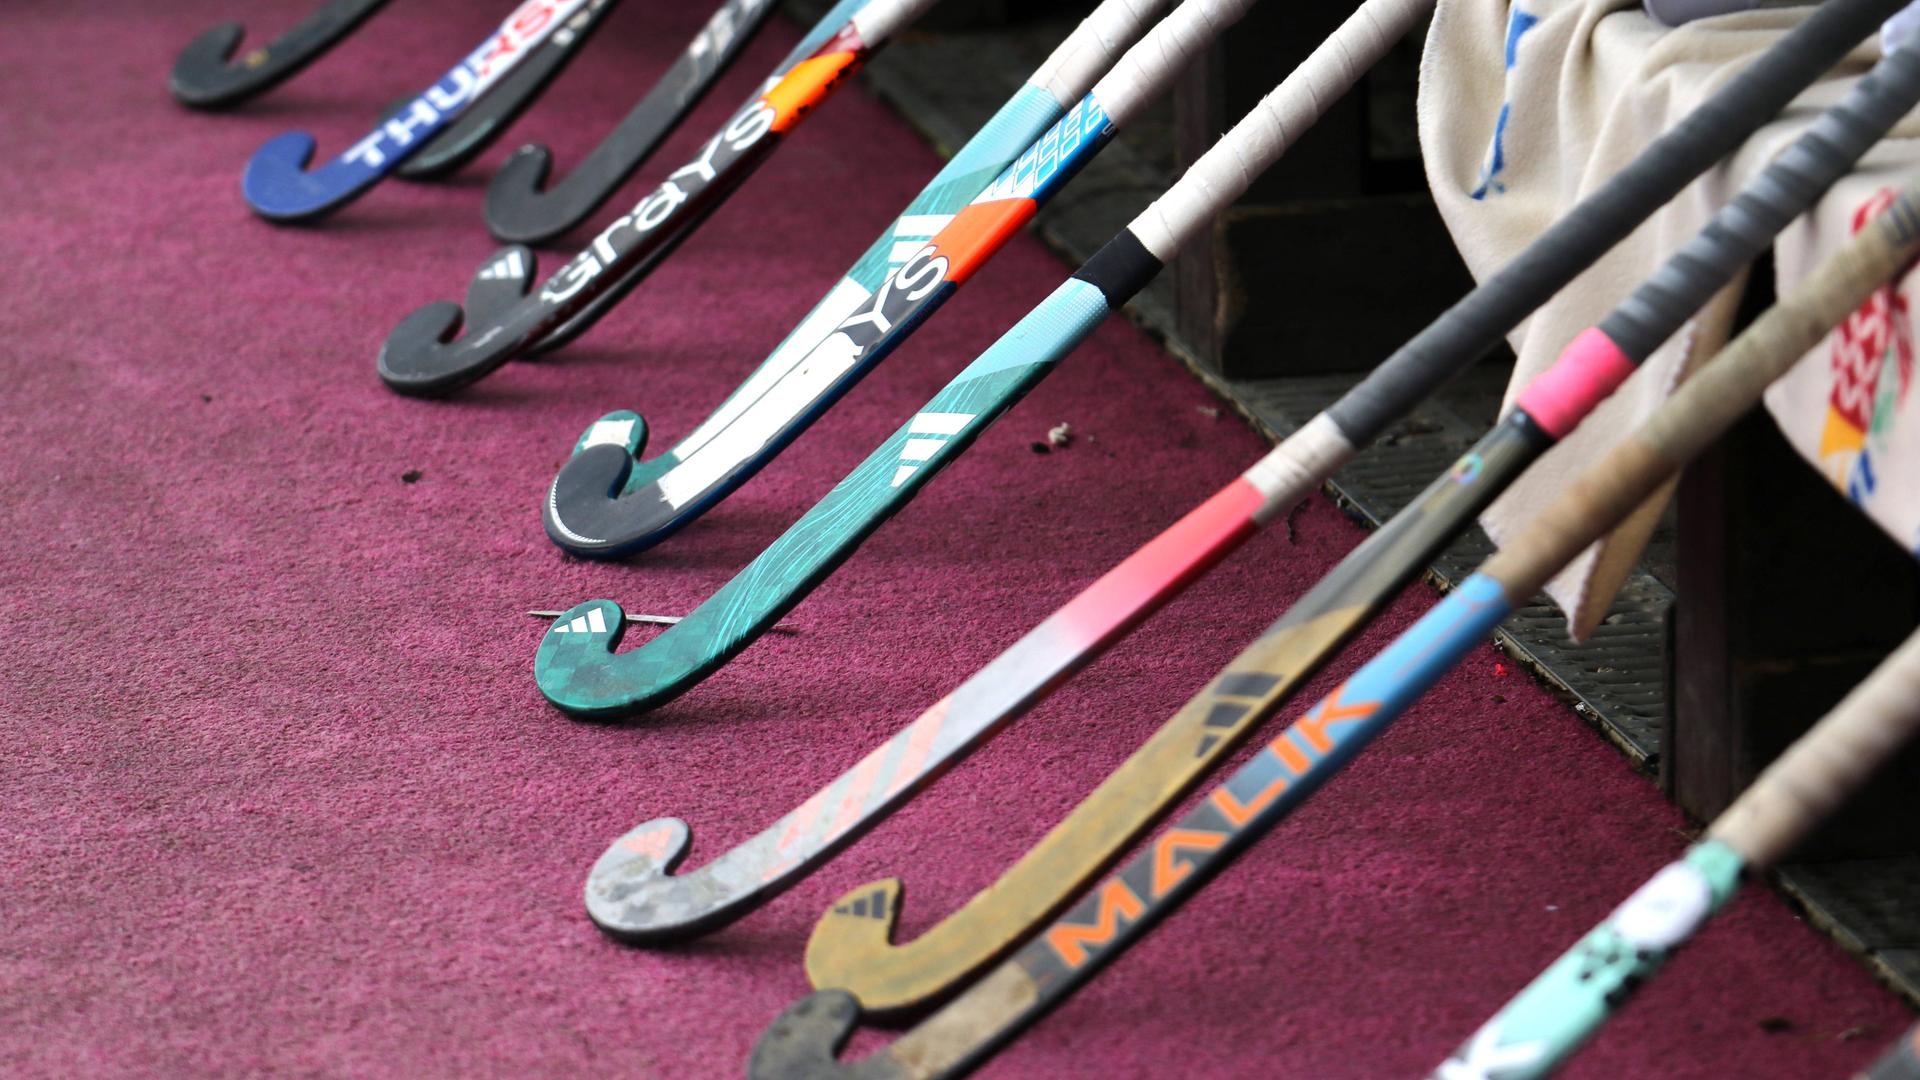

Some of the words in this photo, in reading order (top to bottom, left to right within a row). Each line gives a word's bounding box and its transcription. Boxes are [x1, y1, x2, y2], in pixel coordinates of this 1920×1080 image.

[341, 0, 571, 167] THURS
[837, 244, 950, 334] YS
[1045, 682, 1383, 968] MALIK
